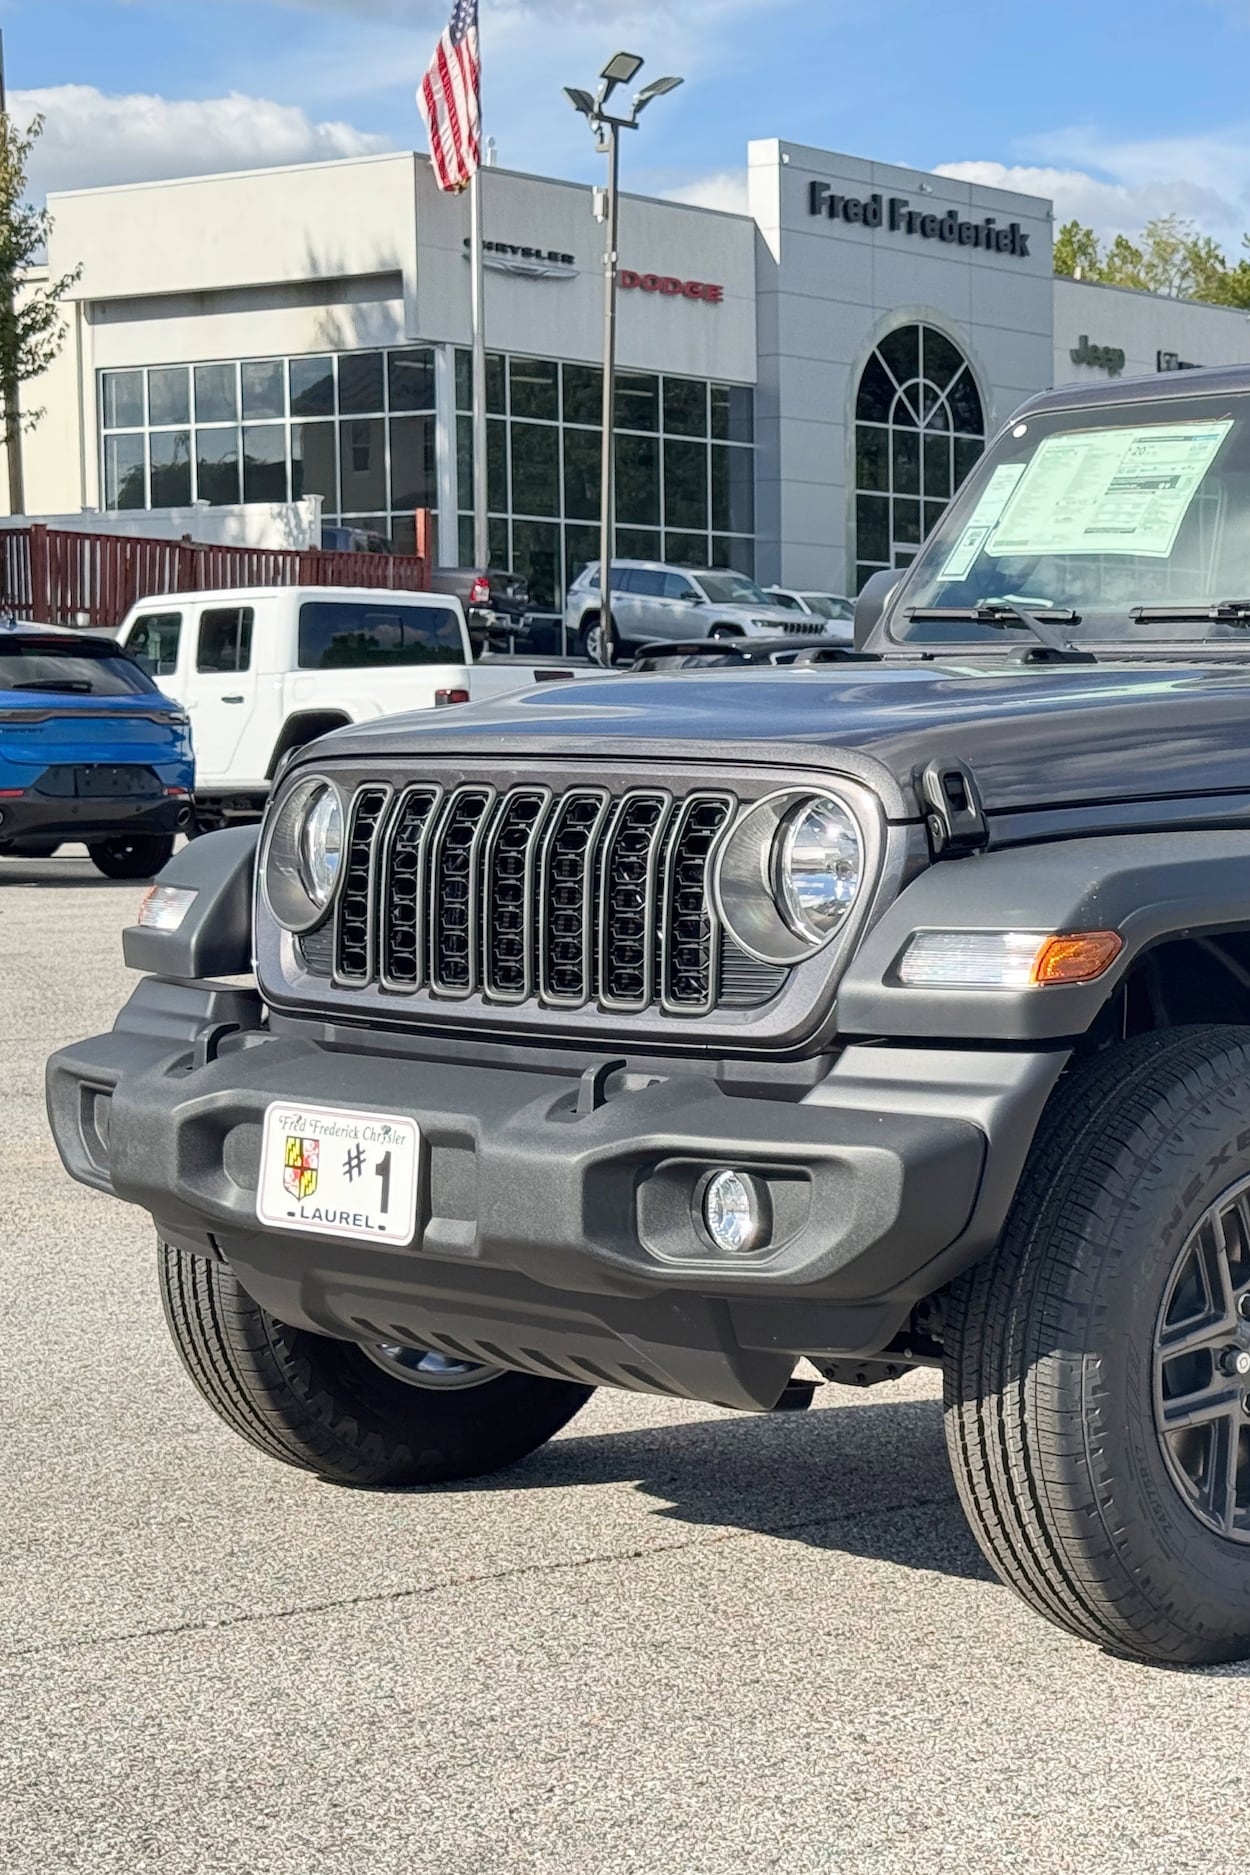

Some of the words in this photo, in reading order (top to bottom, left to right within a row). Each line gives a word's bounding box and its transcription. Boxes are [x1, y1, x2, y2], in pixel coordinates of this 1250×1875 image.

[808, 180, 883, 228] Fred
[888, 197, 1031, 257] Frederick
[617, 269, 725, 303] DODGE
[1070, 335, 1126, 378] Jeep
[278, 1114, 307, 1133] Fred
[309, 1119, 360, 1140] Frederick
[362, 1126, 407, 1147] Chrysler
[300, 1205, 375, 1230] LAUREL
